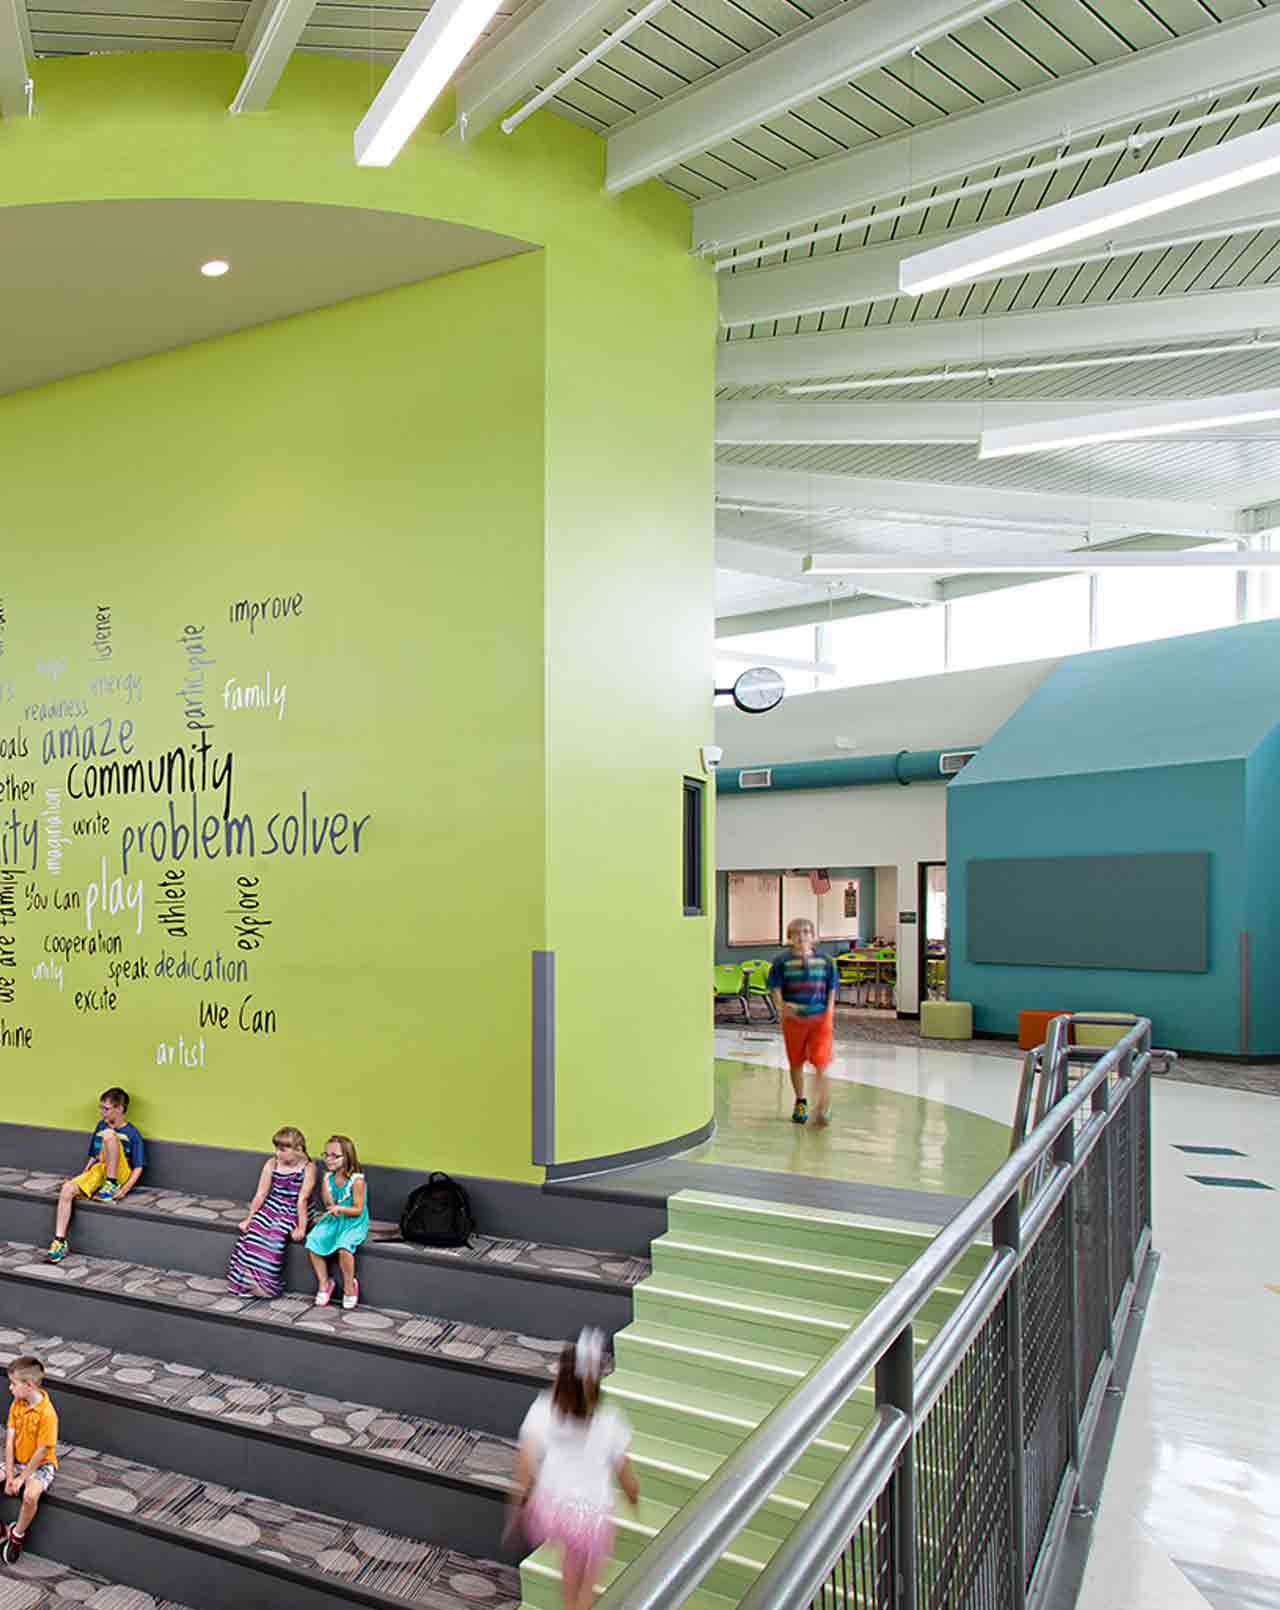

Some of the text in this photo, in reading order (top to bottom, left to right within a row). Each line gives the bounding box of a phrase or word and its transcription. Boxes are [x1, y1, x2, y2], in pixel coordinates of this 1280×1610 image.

[230, 593, 303, 634] improve
[89, 605, 111, 662] listener
[177, 624, 215, 730] participate
[223, 671, 287, 719] family
[25, 698, 88, 720] readiness
[42, 717, 134, 765] amaze
[73, 811, 110, 837] write
[54, 886, 80, 910] Can
[85, 856, 144, 934] play
[155, 869, 186, 937] athlete
[225, 876, 272, 951] explore
[44, 933, 122, 962] cooperation
[154, 949, 248, 983] dedication
[108, 959, 149, 988] speak
[75, 991, 118, 1012] excite
[200, 994, 276, 1033] We Can
[155, 1035, 206, 1068] artist
